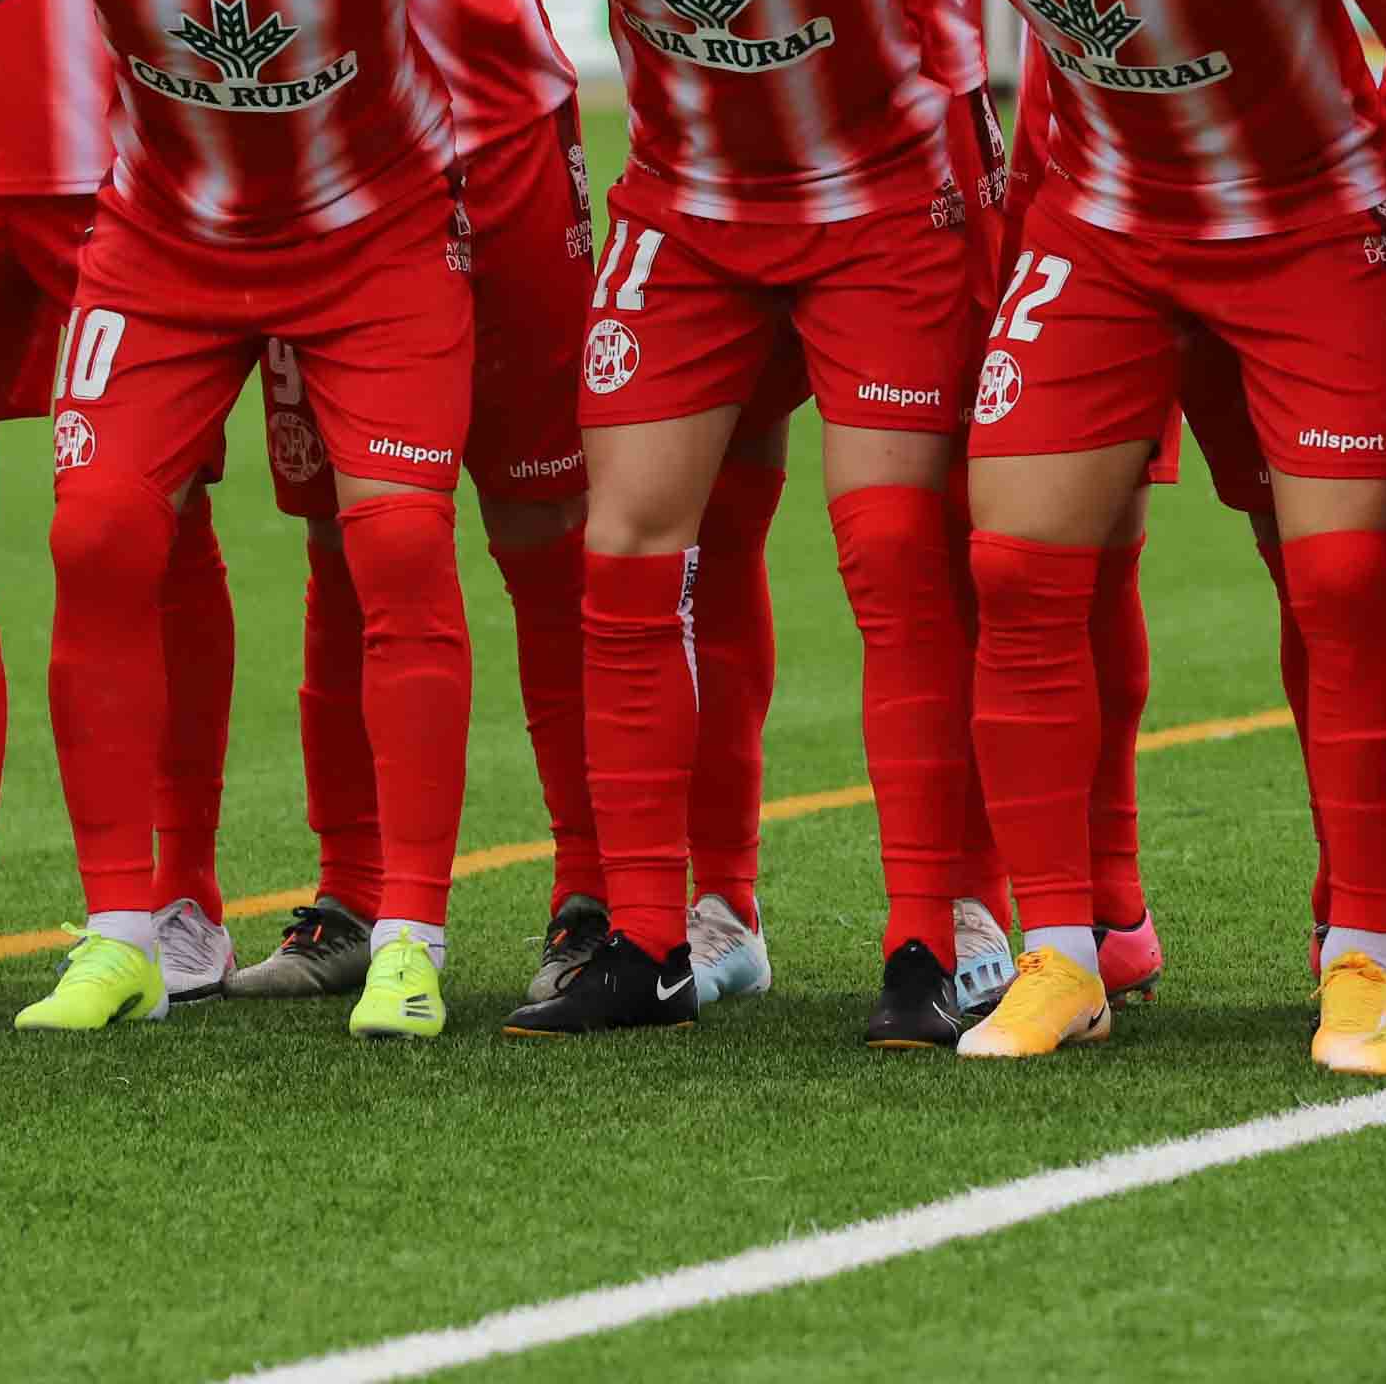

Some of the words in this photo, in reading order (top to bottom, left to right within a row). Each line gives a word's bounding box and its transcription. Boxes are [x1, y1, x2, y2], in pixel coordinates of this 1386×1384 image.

[705, 20, 832, 68] RURAL
[133, 61, 221, 106] CAJA
[230, 59, 354, 108] RURAL
[1098, 56, 1228, 89] RURAL
[592, 219, 665, 310] 11
[989, 250, 1072, 342] 22
[857, 383, 941, 408] uhlsport
[369, 437, 454, 468] uhlsport
[1298, 429, 1384, 453] uhlsport
[509, 448, 585, 480] uhlsport
